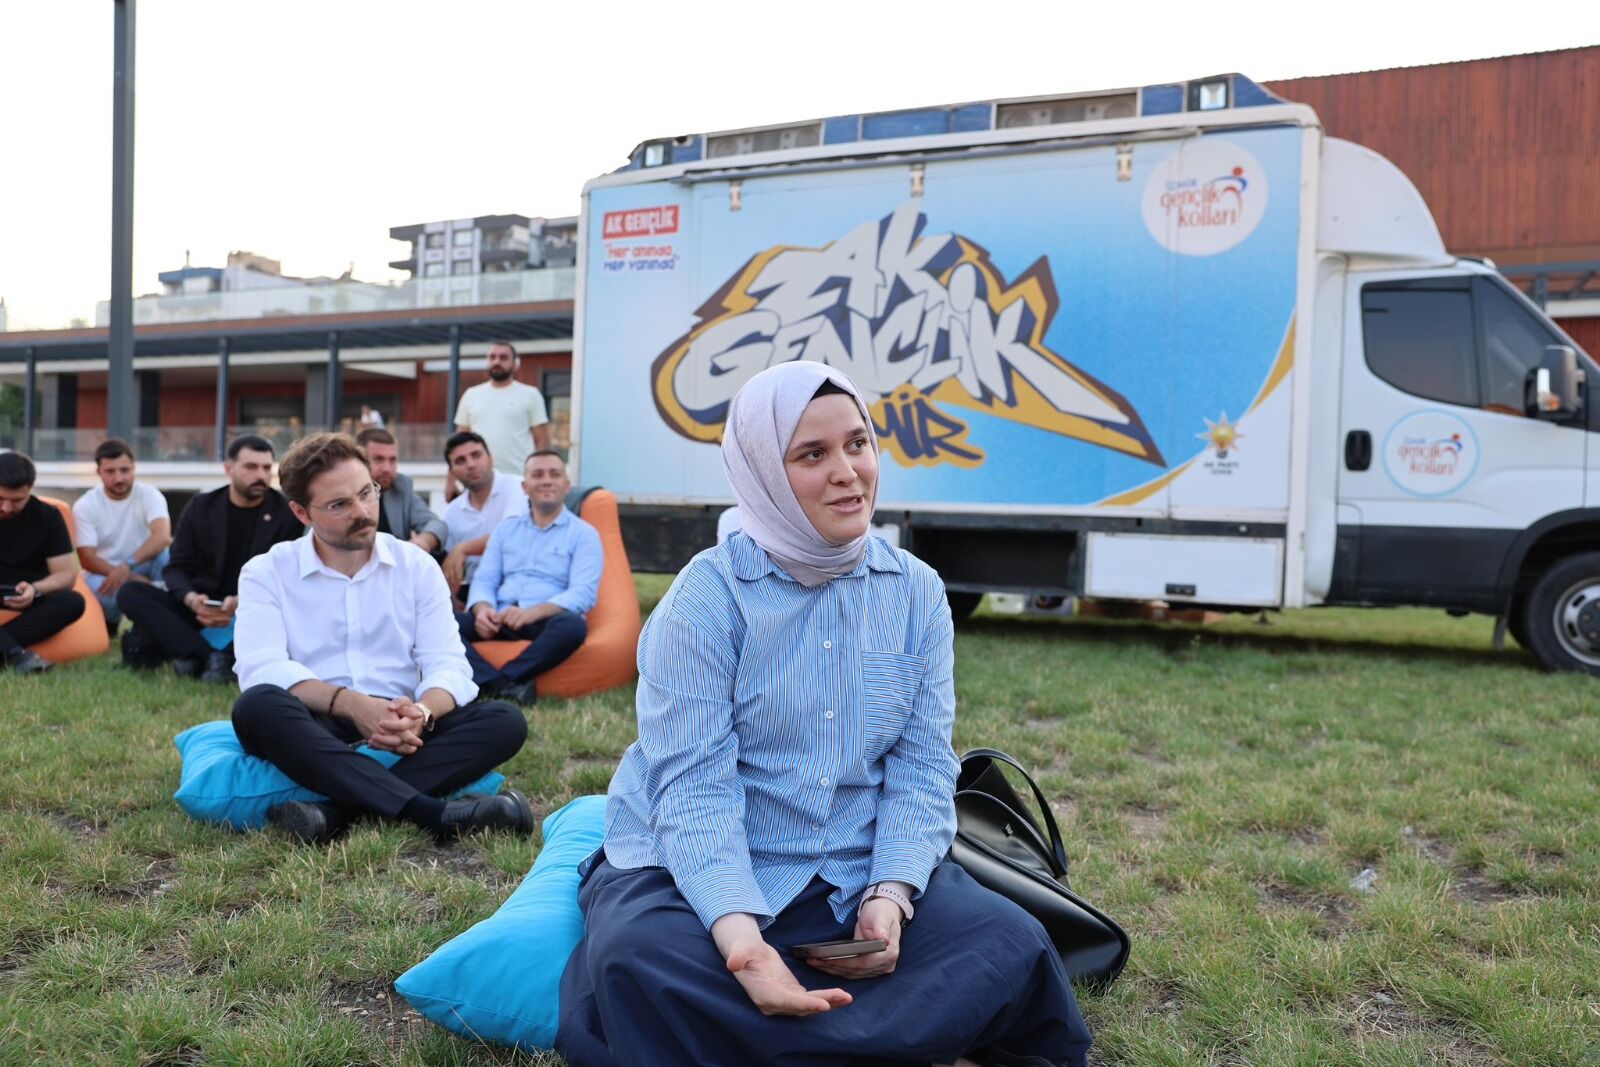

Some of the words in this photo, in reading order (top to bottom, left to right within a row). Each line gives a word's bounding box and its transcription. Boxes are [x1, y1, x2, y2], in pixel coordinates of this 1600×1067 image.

[1160, 183, 1219, 216] gençlik
[606, 214, 624, 233] AK
[624, 207, 675, 235] GENÇLİK
[745, 201, 954, 321] AK
